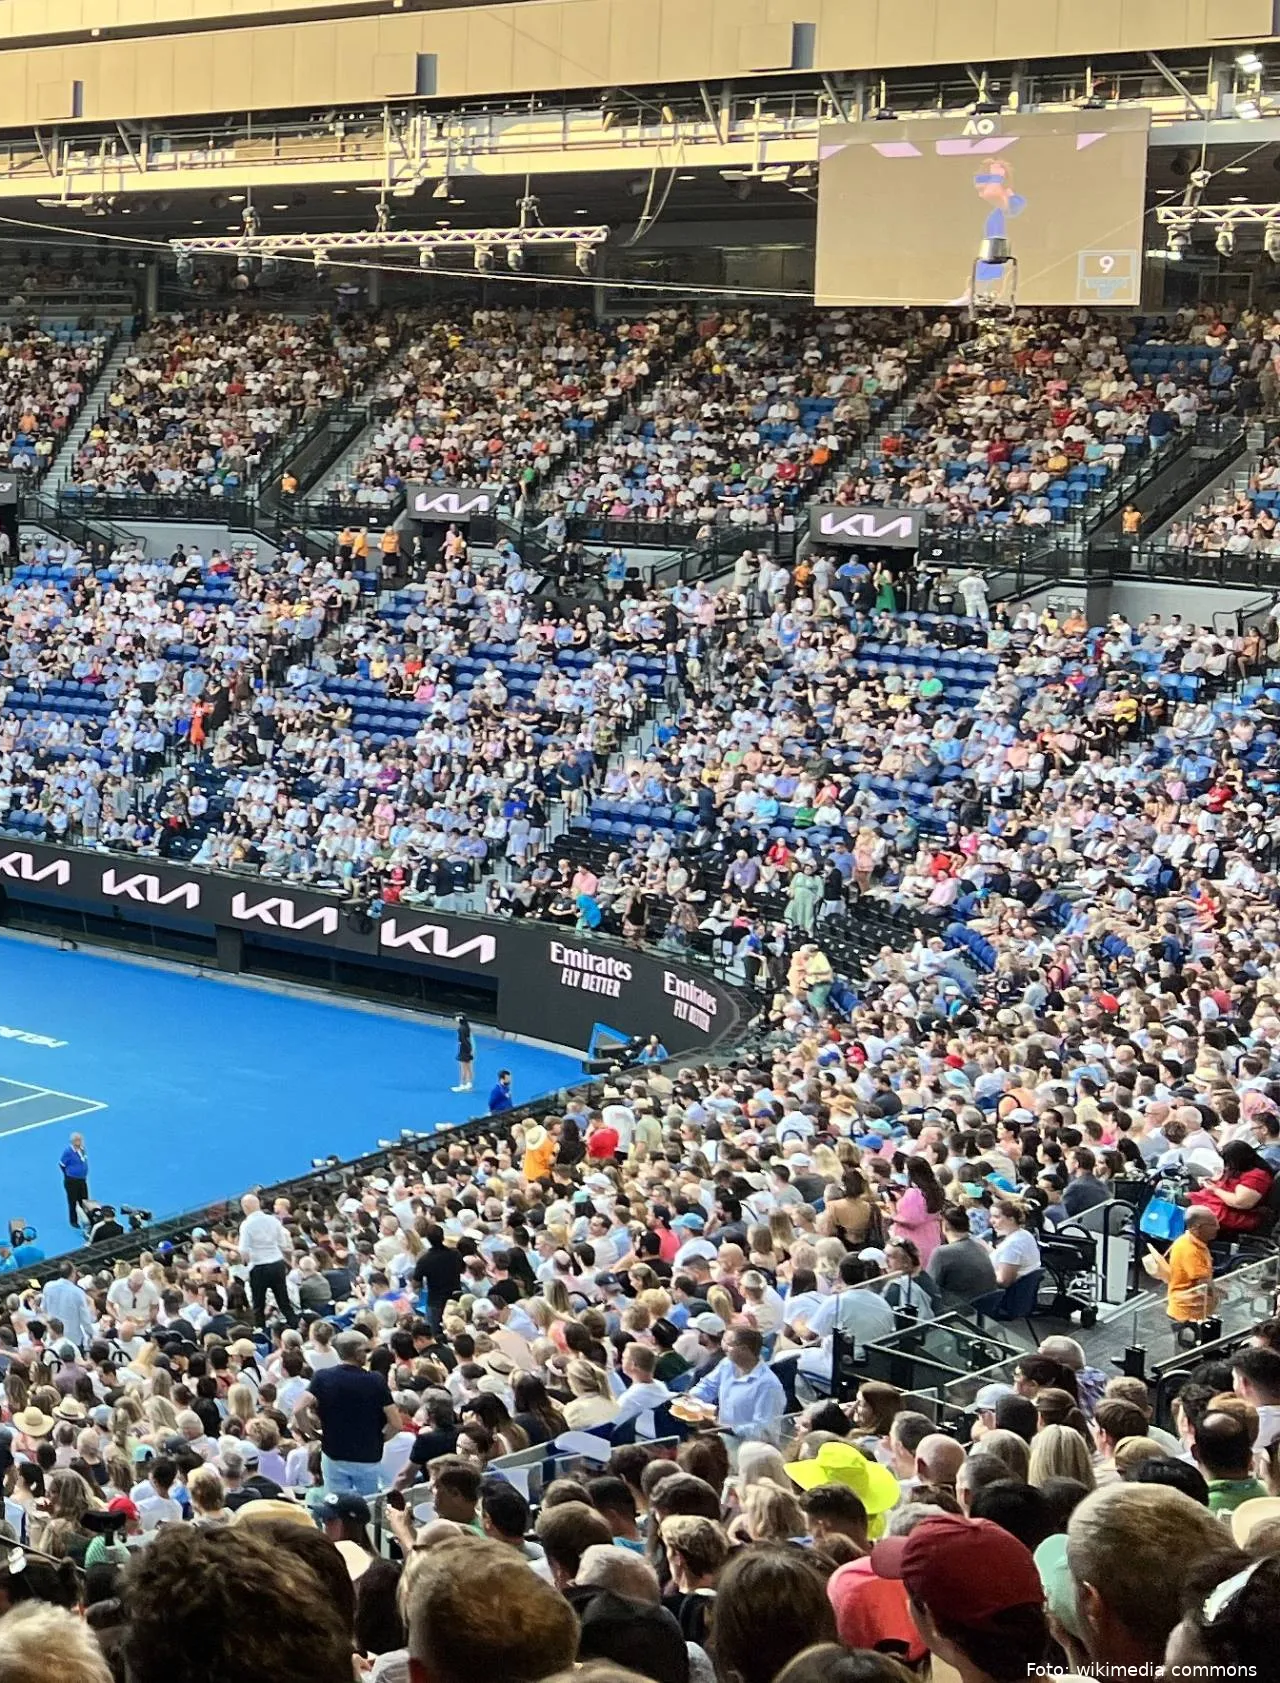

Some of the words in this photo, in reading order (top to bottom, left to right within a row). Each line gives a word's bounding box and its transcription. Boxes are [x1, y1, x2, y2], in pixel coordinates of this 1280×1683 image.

[1099, 255, 1114, 274] 9
[550, 940, 632, 980] Emirates
[561, 967, 581, 988] FLY
[581, 972, 621, 998] BETTER
[664, 970, 717, 1016] Emirates
